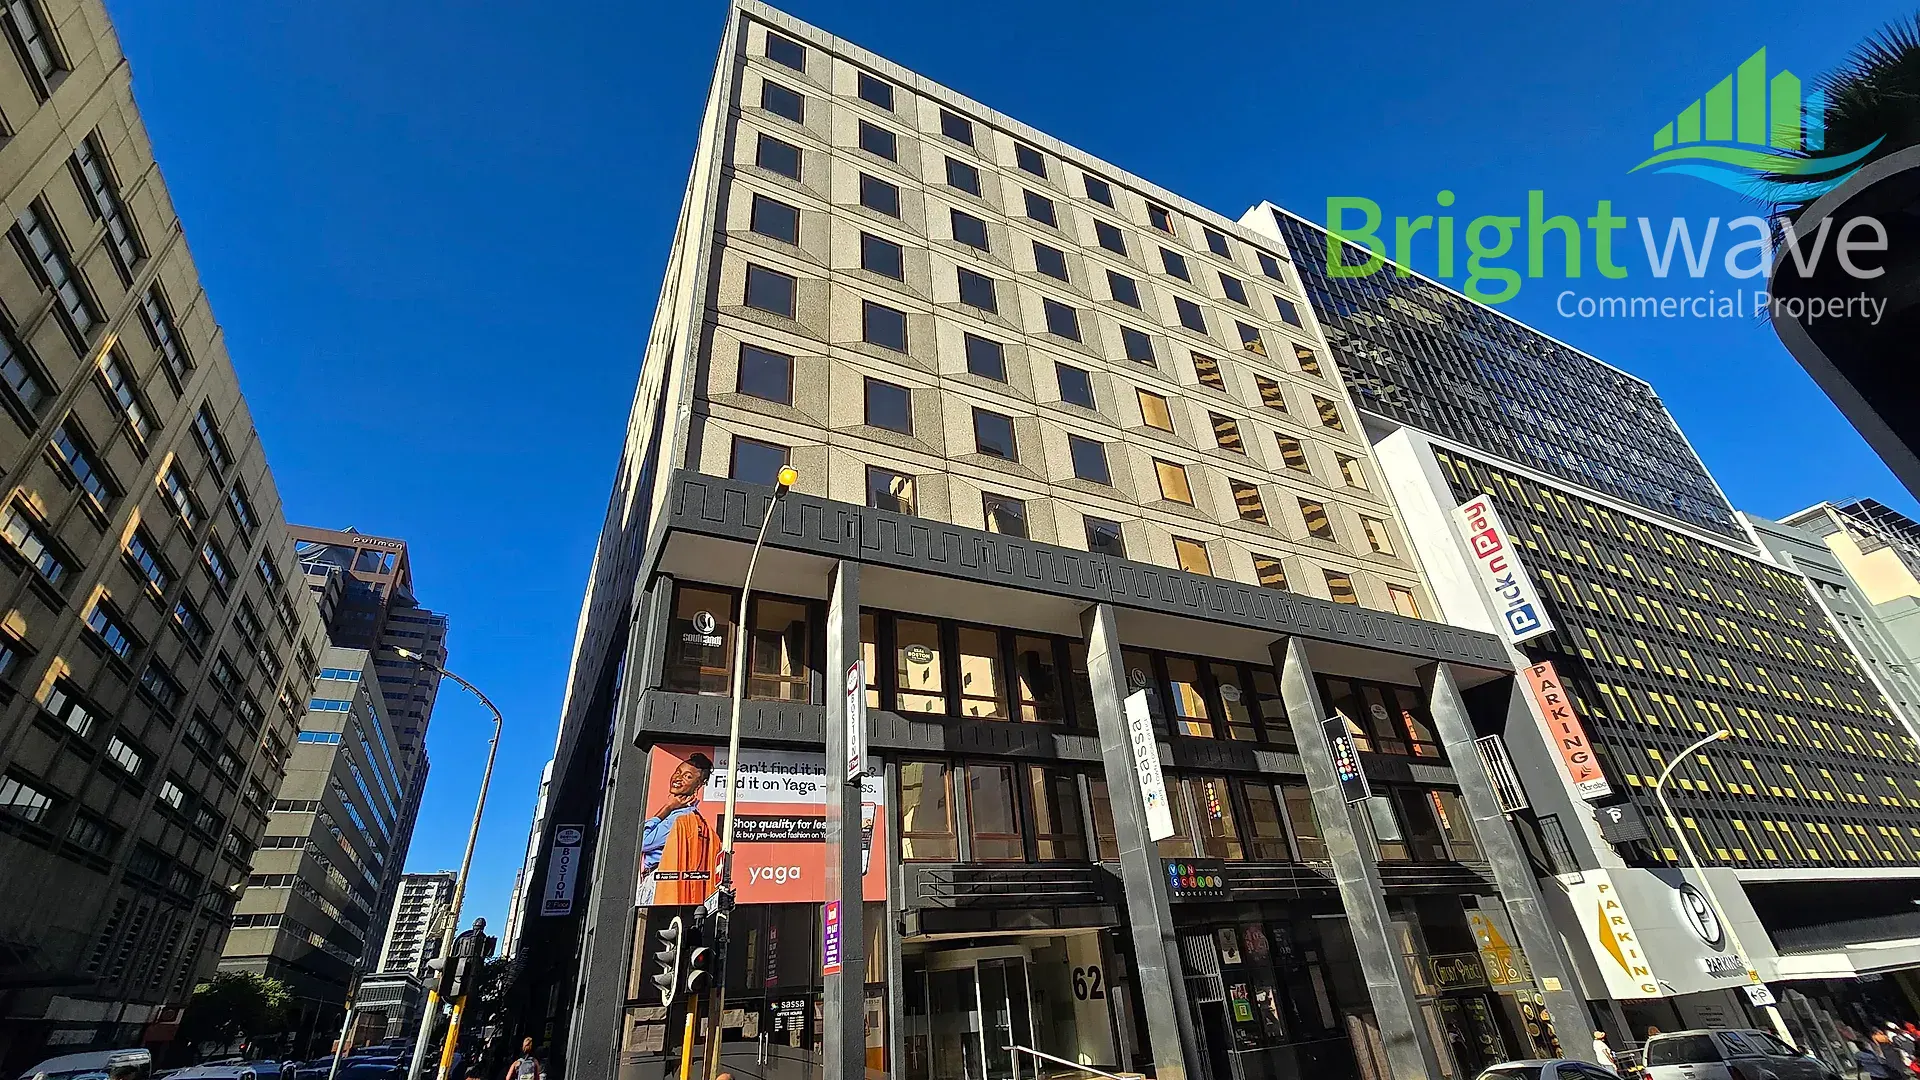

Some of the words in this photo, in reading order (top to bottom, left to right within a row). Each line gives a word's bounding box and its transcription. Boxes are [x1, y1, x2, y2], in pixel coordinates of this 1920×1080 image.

[1464, 502, 1500, 557] Pay
[353, 537, 403, 550] pullman
[1489, 555, 1508, 573] n
[1495, 572, 1538, 634] Pick
[1533, 666, 1589, 764] PARKING
[1132, 718, 1153, 785] sassa
[737, 761, 767, 774] an't
[770, 762, 798, 775] find
[801, 763, 811, 776] it
[814, 763, 826, 776] in
[714, 775, 745, 789] Fid
[749, 776, 759, 790] it
[762, 780, 779, 790] on
[782, 777, 817, 796] Yaga
[758, 818, 796, 832] quality
[797, 819, 812, 829] for
[742, 831, 756, 840] buy
[555, 847, 571, 899] BOSTON
[748, 865, 801, 885] yaga
[1598, 884, 1657, 993] PARKING
[1705, 954, 1744, 972] PARKING
[1073, 965, 1105, 1001] 62
[781, 1000, 805, 1009] sassa
